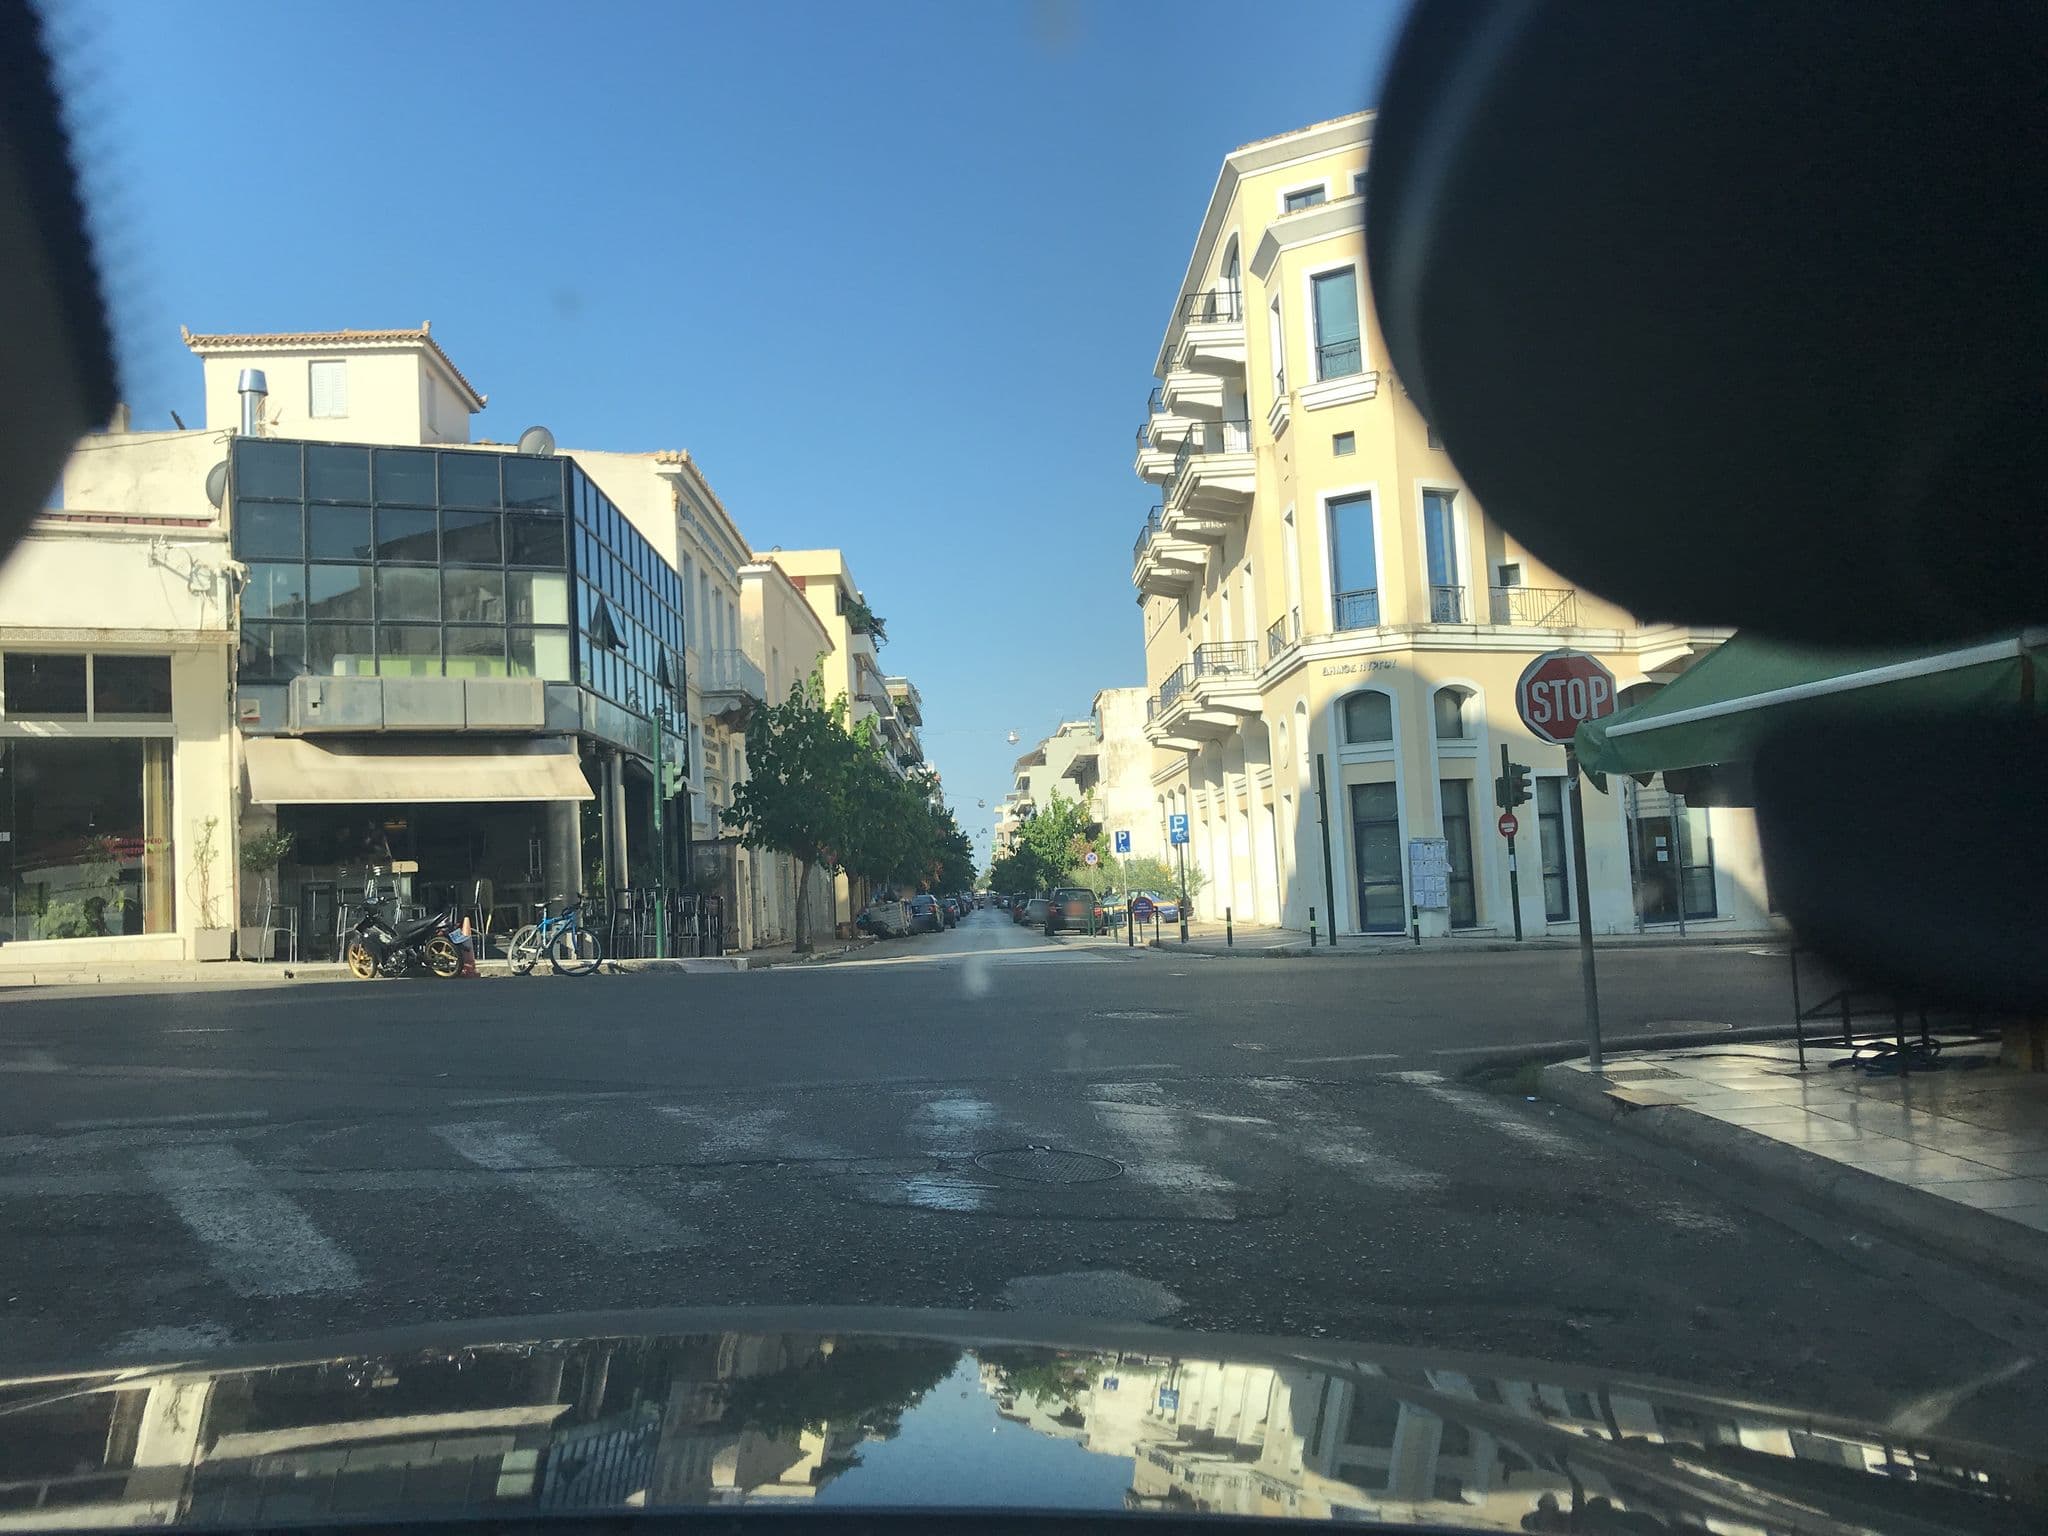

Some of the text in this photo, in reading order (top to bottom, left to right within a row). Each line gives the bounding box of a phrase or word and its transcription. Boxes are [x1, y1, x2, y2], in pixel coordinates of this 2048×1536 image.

[1531, 676, 1609, 723] STOP
[1173, 816, 1185, 830] P
[1118, 832, 1127, 843] P
